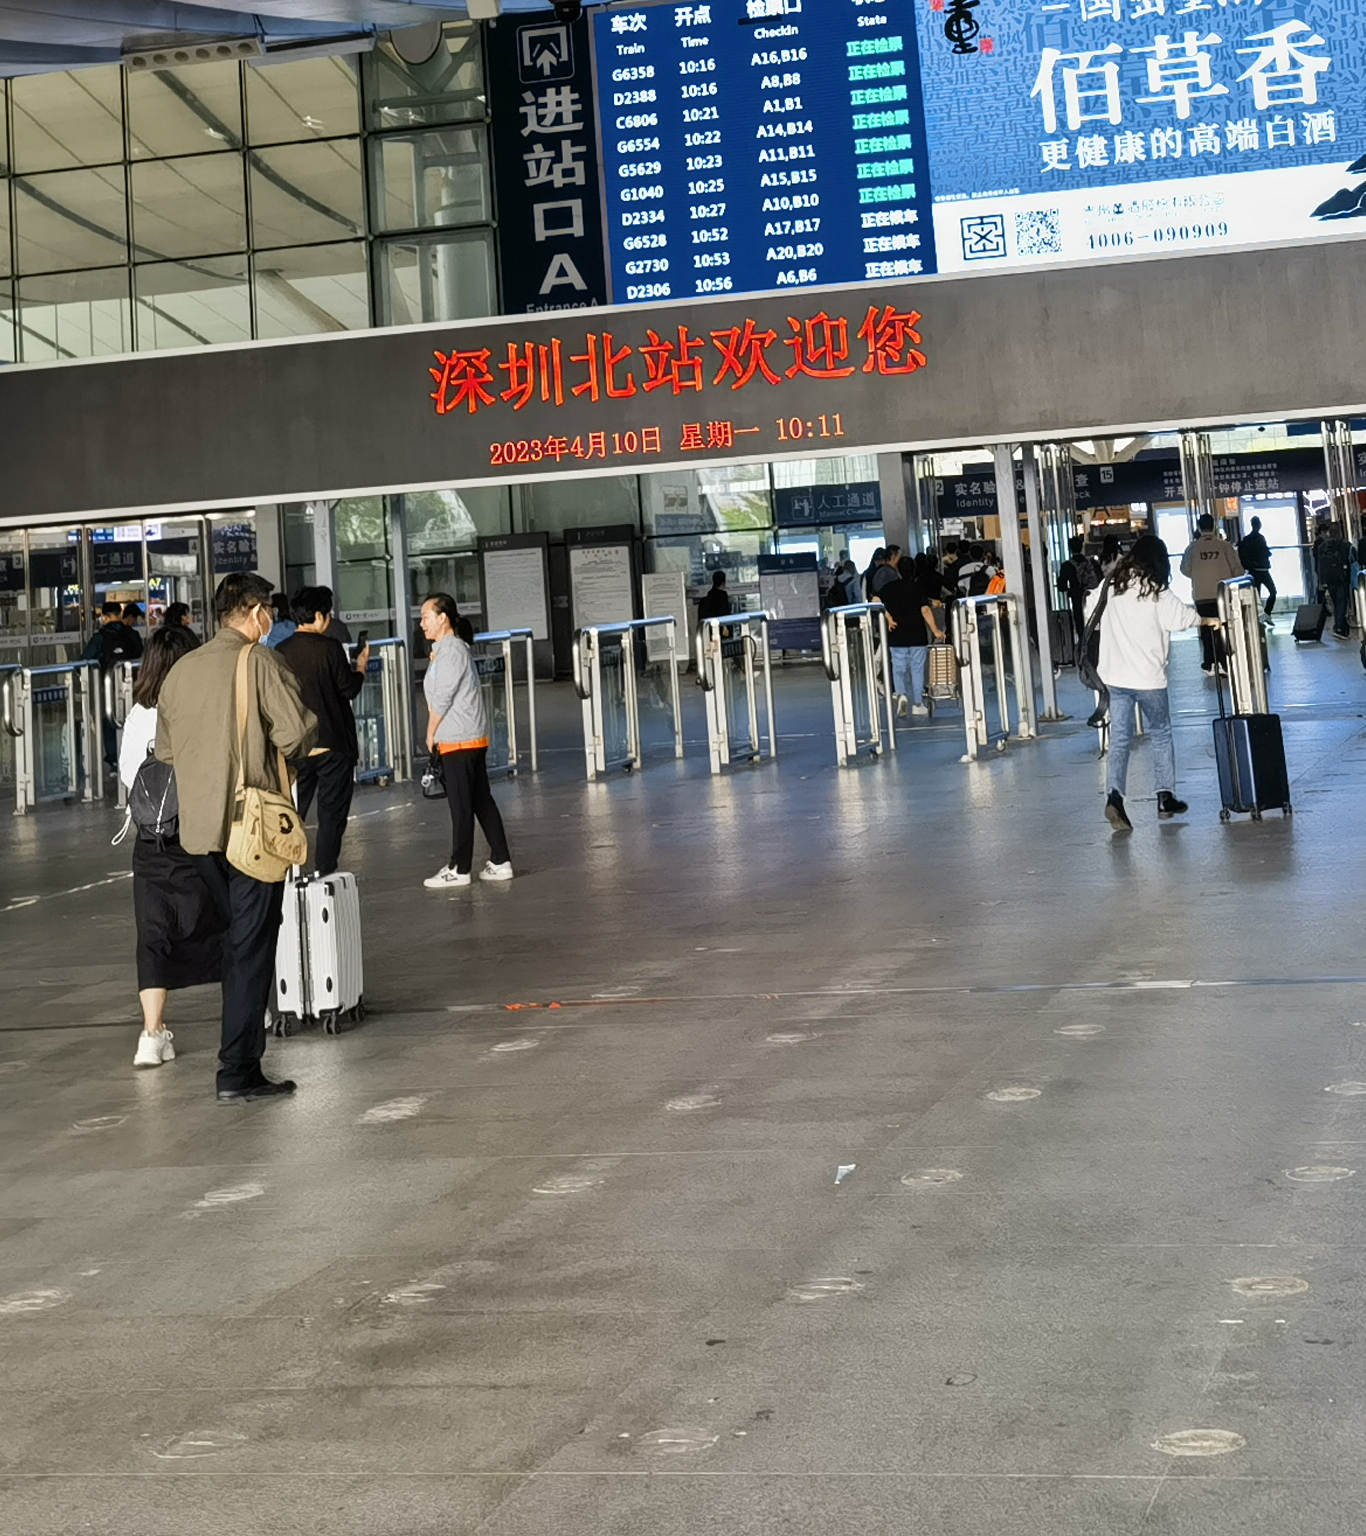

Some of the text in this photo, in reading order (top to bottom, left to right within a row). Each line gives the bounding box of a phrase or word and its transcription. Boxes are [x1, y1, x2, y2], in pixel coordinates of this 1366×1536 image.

[611, 13, 647, 34] 车次
[674, 5, 712, 27] 开点
[857, 15, 887, 27] State
[616, 43, 645, 56] Train
[681, 35, 709, 49] Time
[846, 36, 903, 57] 正在检票
[751, 47, 807, 66] A16,B16
[612, 65, 655, 82] G6358
[679, 58, 716, 75] 10:16
[848, 60, 905, 81] 正在检票
[761, 72, 801, 90] A8,B8
[1030, 19, 1333, 134] 佰草香
[613, 89, 657, 106] D2388
[681, 82, 718, 99] 10:16
[850, 85, 907, 106] 正在检票
[763, 96, 803, 114] A1,B1
[615, 113, 658, 130] C6806
[682, 106, 719, 123] 10:21
[852, 109, 910, 130] 正在检票
[684, 130, 721, 147] 10:22
[756, 120, 813, 139] A14,B14
[617, 137, 660, 154] G6554
[854, 134, 912, 155] 正在检票
[1038, 108, 1337, 173] 更健康的高端白酒
[686, 154, 723, 171] 10:23
[758, 145, 815, 163] A11,B11
[618, 161, 662, 178] G5629
[856, 158, 914, 179] 正在检票
[688, 178, 725, 195] 10:25
[760, 169, 817, 188] A15,B15
[620, 185, 664, 202] G1040
[762, 193, 819, 212] A10,B10
[859, 183, 916, 204] 正在检票
[621, 209, 665, 226] D2334
[689, 203, 727, 220] 10:27
[861, 208, 918, 229] 正在候车
[691, 227, 729, 244] 10:52
[764, 218, 821, 237] A17,B17
[623, 234, 667, 251] G6528
[766, 242, 823, 261] A20,B20
[863, 233, 921, 254] 正在候车
[625, 258, 669, 275] G2730
[693, 251, 731, 268] 10:53
[865, 257, 923, 278] 正在候车
[695, 276, 733, 293] 10:56
[776, 268, 817, 286] A6,B6
[627, 282, 671, 300] D2306
[430, 304, 927, 415] 深圳北站欢迎您
[490, 413, 845, 465] 2023年4月10日 星期一 10:11
[1101, 470, 1113, 480] 15
[955, 482, 996, 496] 实名验
[818, 491, 875, 509] 人工通道
[956, 497, 994, 508] Identity
[97, 551, 135, 566] 工通道
